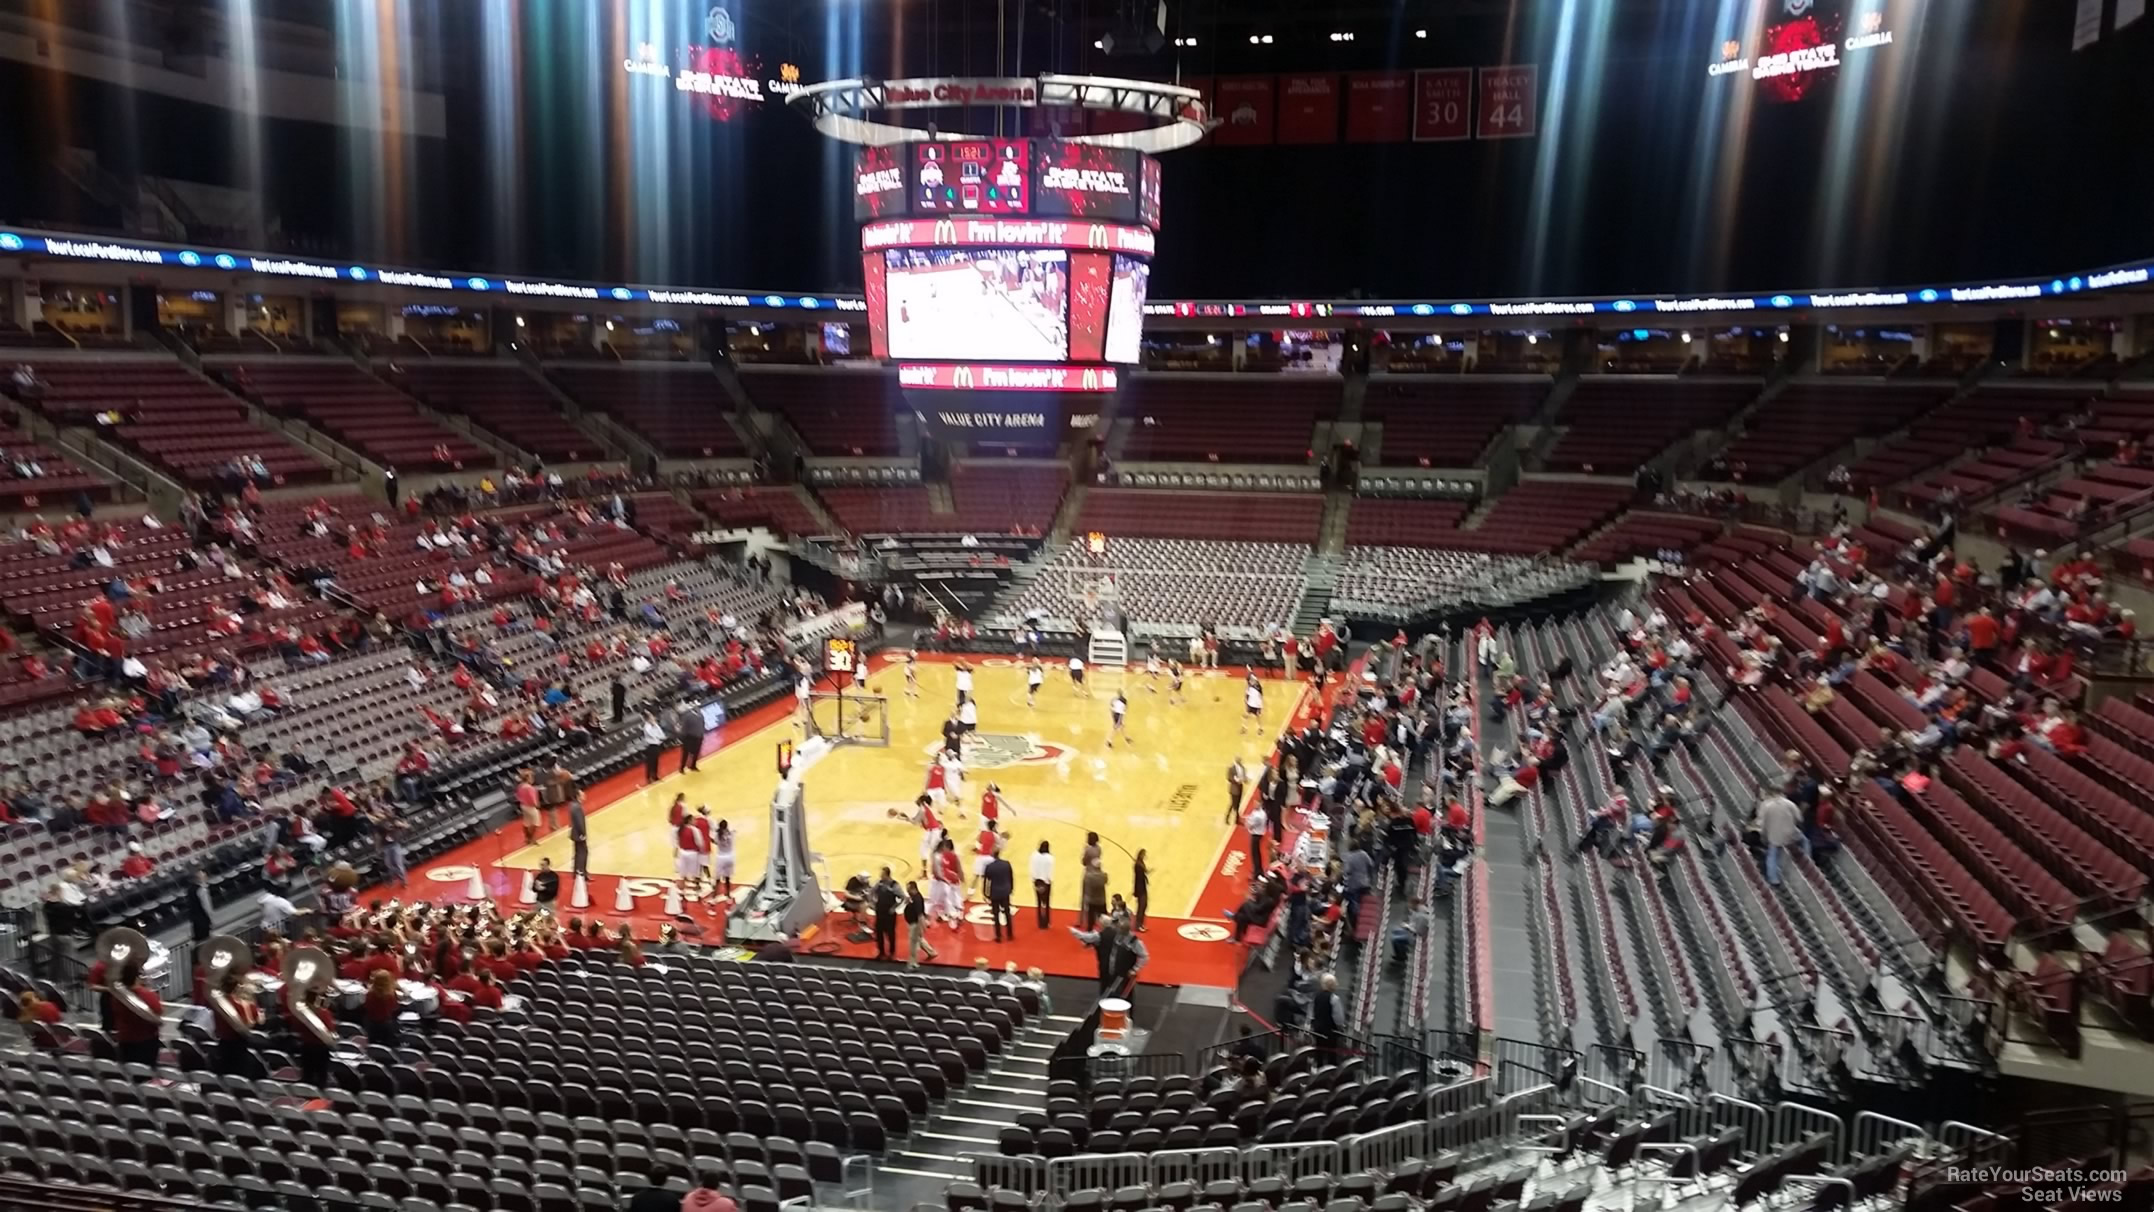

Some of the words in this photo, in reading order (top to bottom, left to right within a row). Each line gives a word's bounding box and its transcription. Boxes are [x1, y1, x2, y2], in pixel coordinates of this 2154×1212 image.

[1487, 75, 1529, 88] TRACEY
[882, 84, 931, 102] Value
[934, 83, 973, 105] City
[975, 83, 1034, 101] Arena
[1493, 89, 1521, 100] HALL
[1427, 101, 1459, 125] 30
[1489, 103, 1523, 129] 44
[44, 238, 162, 264] YourLocalFordStores.com
[938, 411, 973, 428] VALUE
[974, 411, 1003, 428] CITY
[1004, 412, 1046, 429] ARENA
